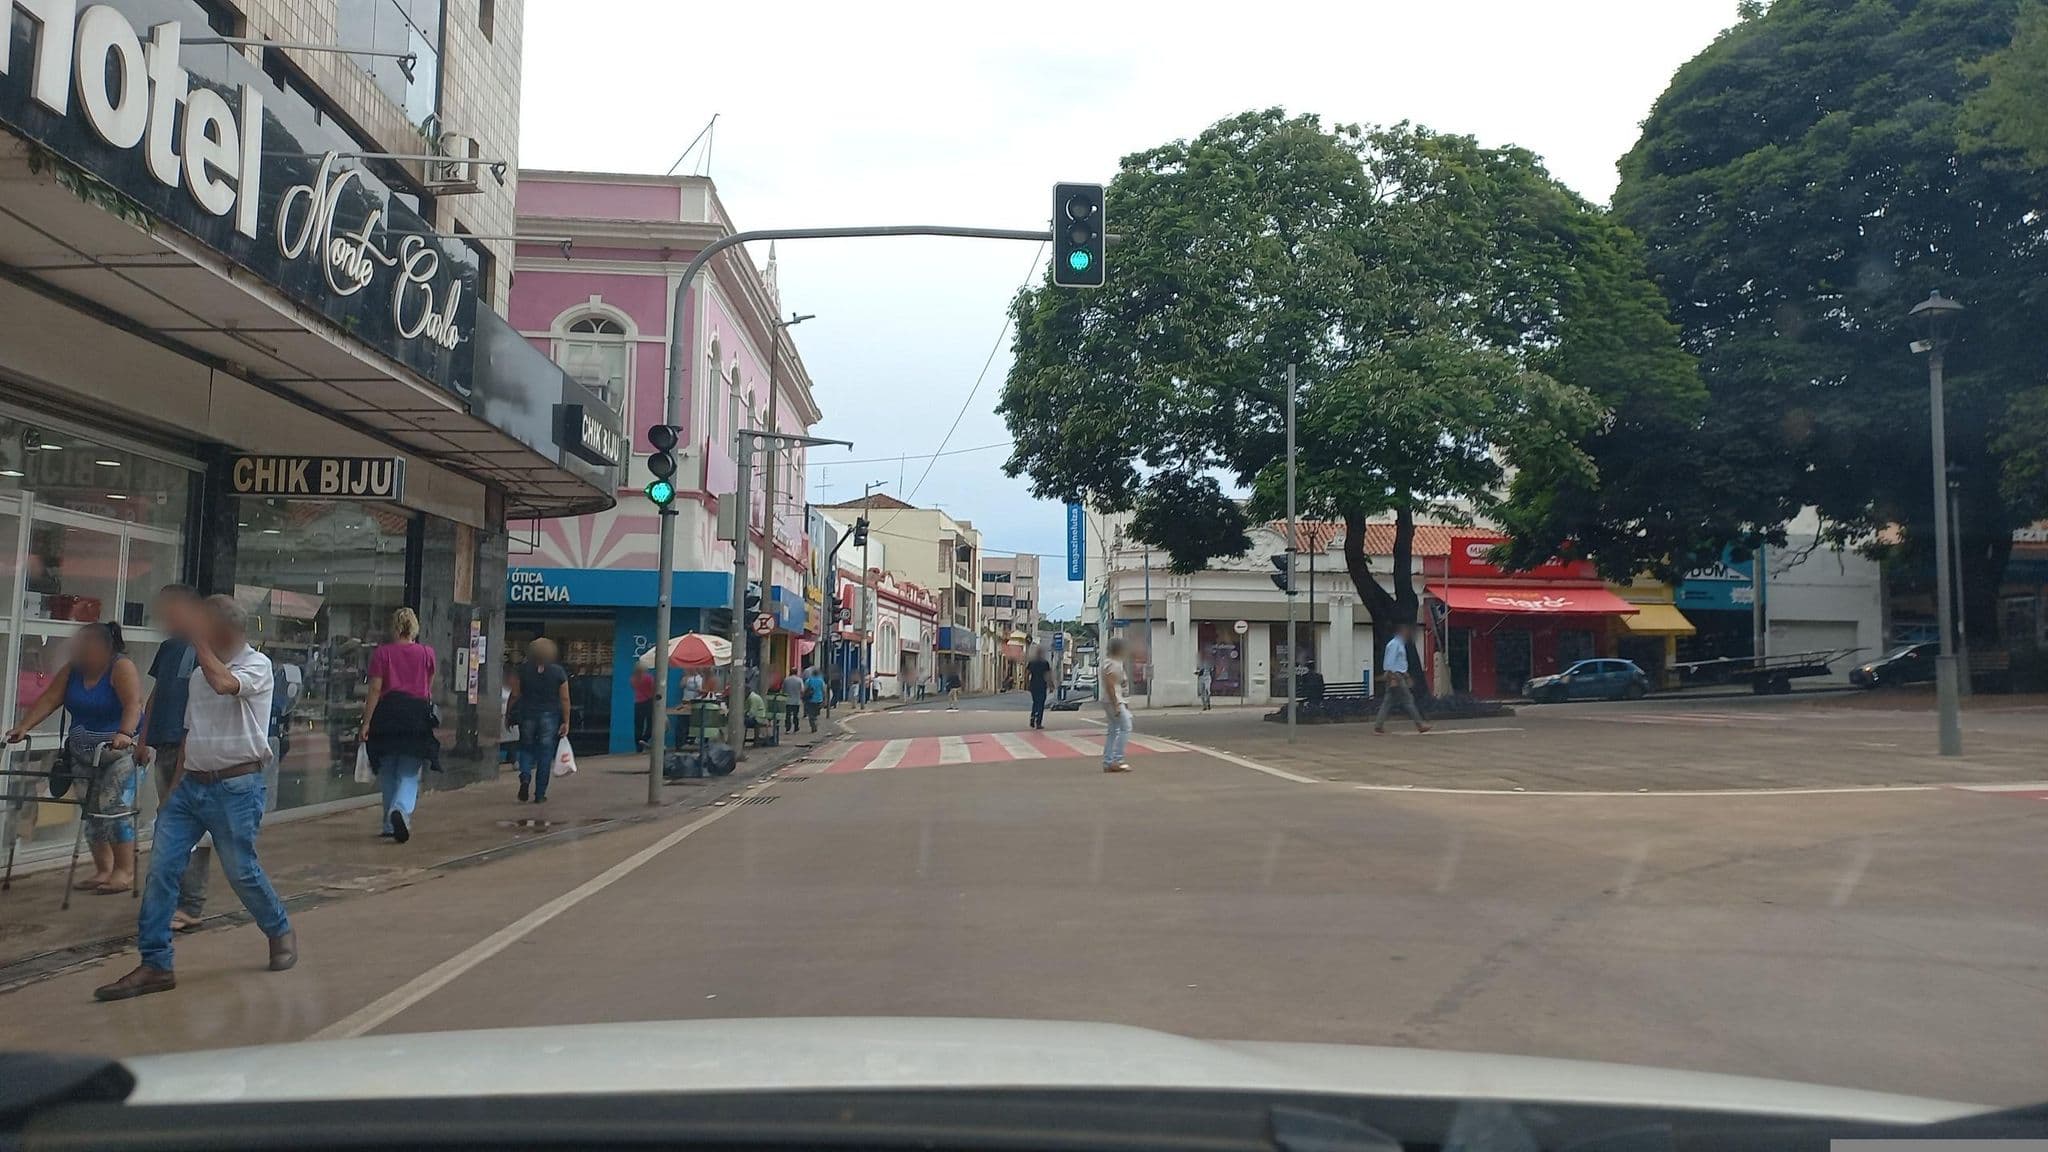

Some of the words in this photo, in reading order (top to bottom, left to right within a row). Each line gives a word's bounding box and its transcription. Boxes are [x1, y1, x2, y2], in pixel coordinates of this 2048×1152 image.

[277, 150, 398, 296] Monte
[393, 234, 468, 351] Carlo
[582, 414, 602, 452] CHIK
[233, 457, 311, 492] CHIK
[320, 459, 391, 495] BIJU
[511, 568, 544, 584] ÓTICA
[511, 585, 570, 602] CREMA
